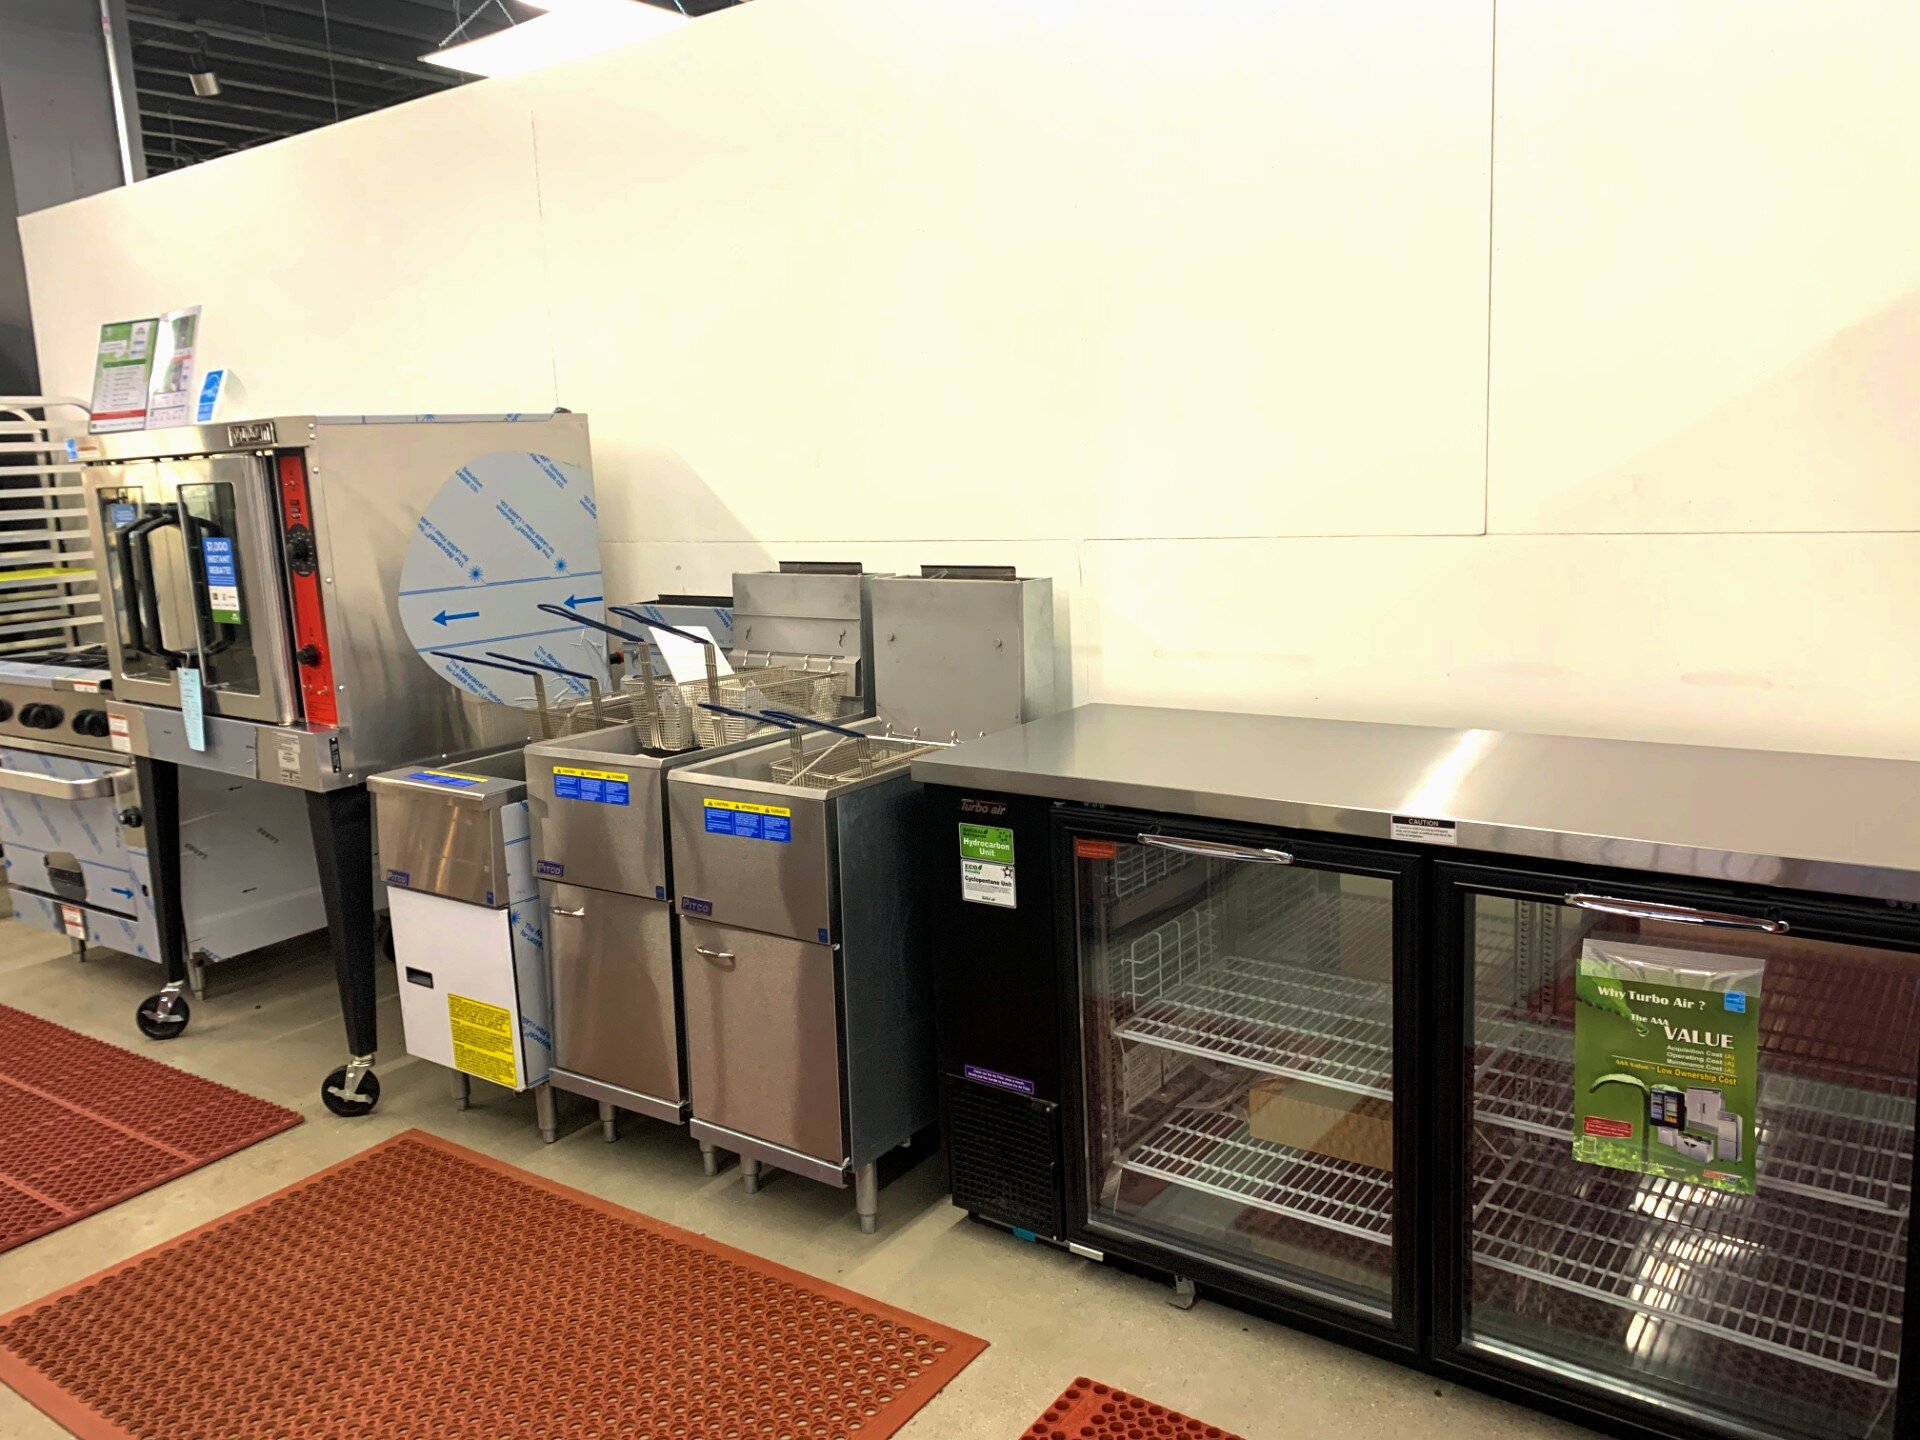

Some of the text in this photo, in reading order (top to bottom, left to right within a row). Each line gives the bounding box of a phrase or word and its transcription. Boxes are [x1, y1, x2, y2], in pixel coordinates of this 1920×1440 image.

[206, 541, 229, 553] $1,000
[447, 541, 462, 555] LASER
[542, 549, 551, 559] The
[454, 557, 465, 567] The
[1409, 819, 1439, 827] CAUTION
[963, 837, 1010, 851] Hydrocarbon
[980, 848, 994, 856] Unit
[965, 875, 999, 885] Cyclopentane
[1598, 986, 1706, 1010] Why Turbo Air ?
[1631, 1014, 1669, 1026] The AAA
[1664, 1026, 1734, 1049] VALUE
[1666, 1045, 1704, 1056] Acquisition
[1706, 1050, 1722, 1058] Cost
[1666, 1052, 1704, 1063] Operating
[1706, 1057, 1722, 1065] Cost
[1666, 1058, 1704, 1069] Maintenance
[1706, 1064, 1722, 1072] Cost
[1656, 1065, 1672, 1075] Low
[1674, 1068, 1717, 1083] Ownership
[1718, 1076, 1736, 1085] Cost
